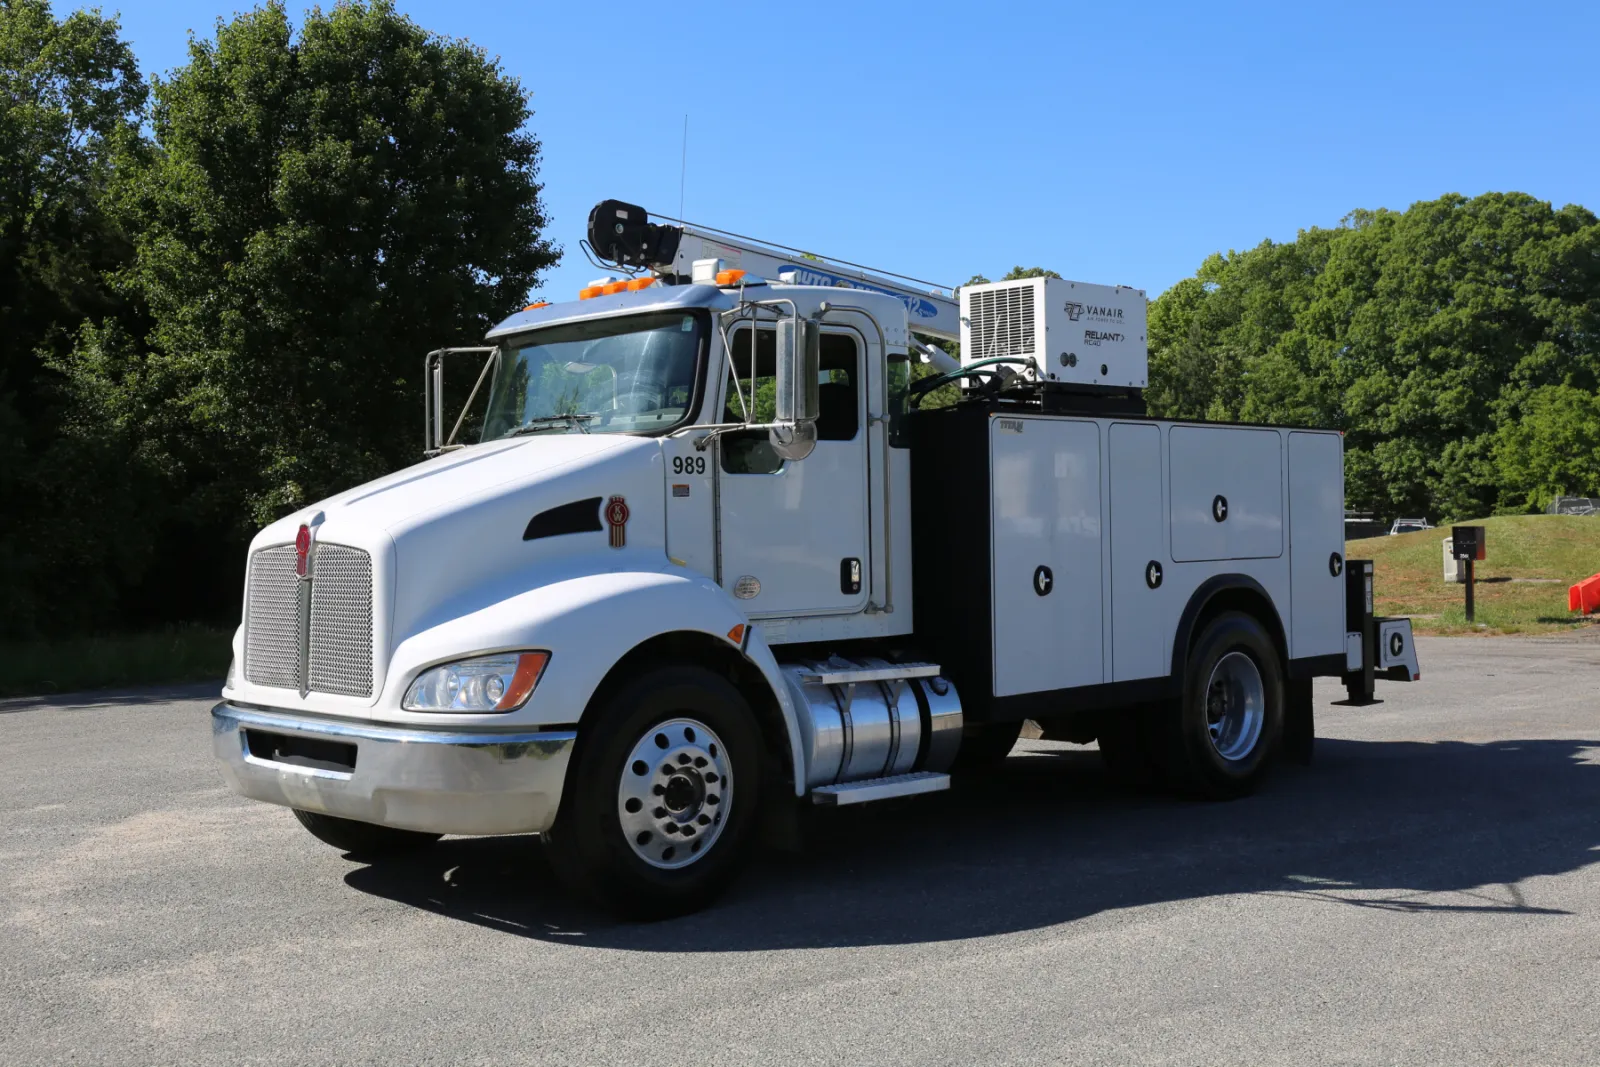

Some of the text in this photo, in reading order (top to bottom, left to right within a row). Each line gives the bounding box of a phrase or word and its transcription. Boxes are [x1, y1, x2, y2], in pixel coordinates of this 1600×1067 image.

[1086, 305, 1123, 318] VANAIR
[1084, 330, 1120, 342] RELIANT
[673, 456, 705, 474] 989
